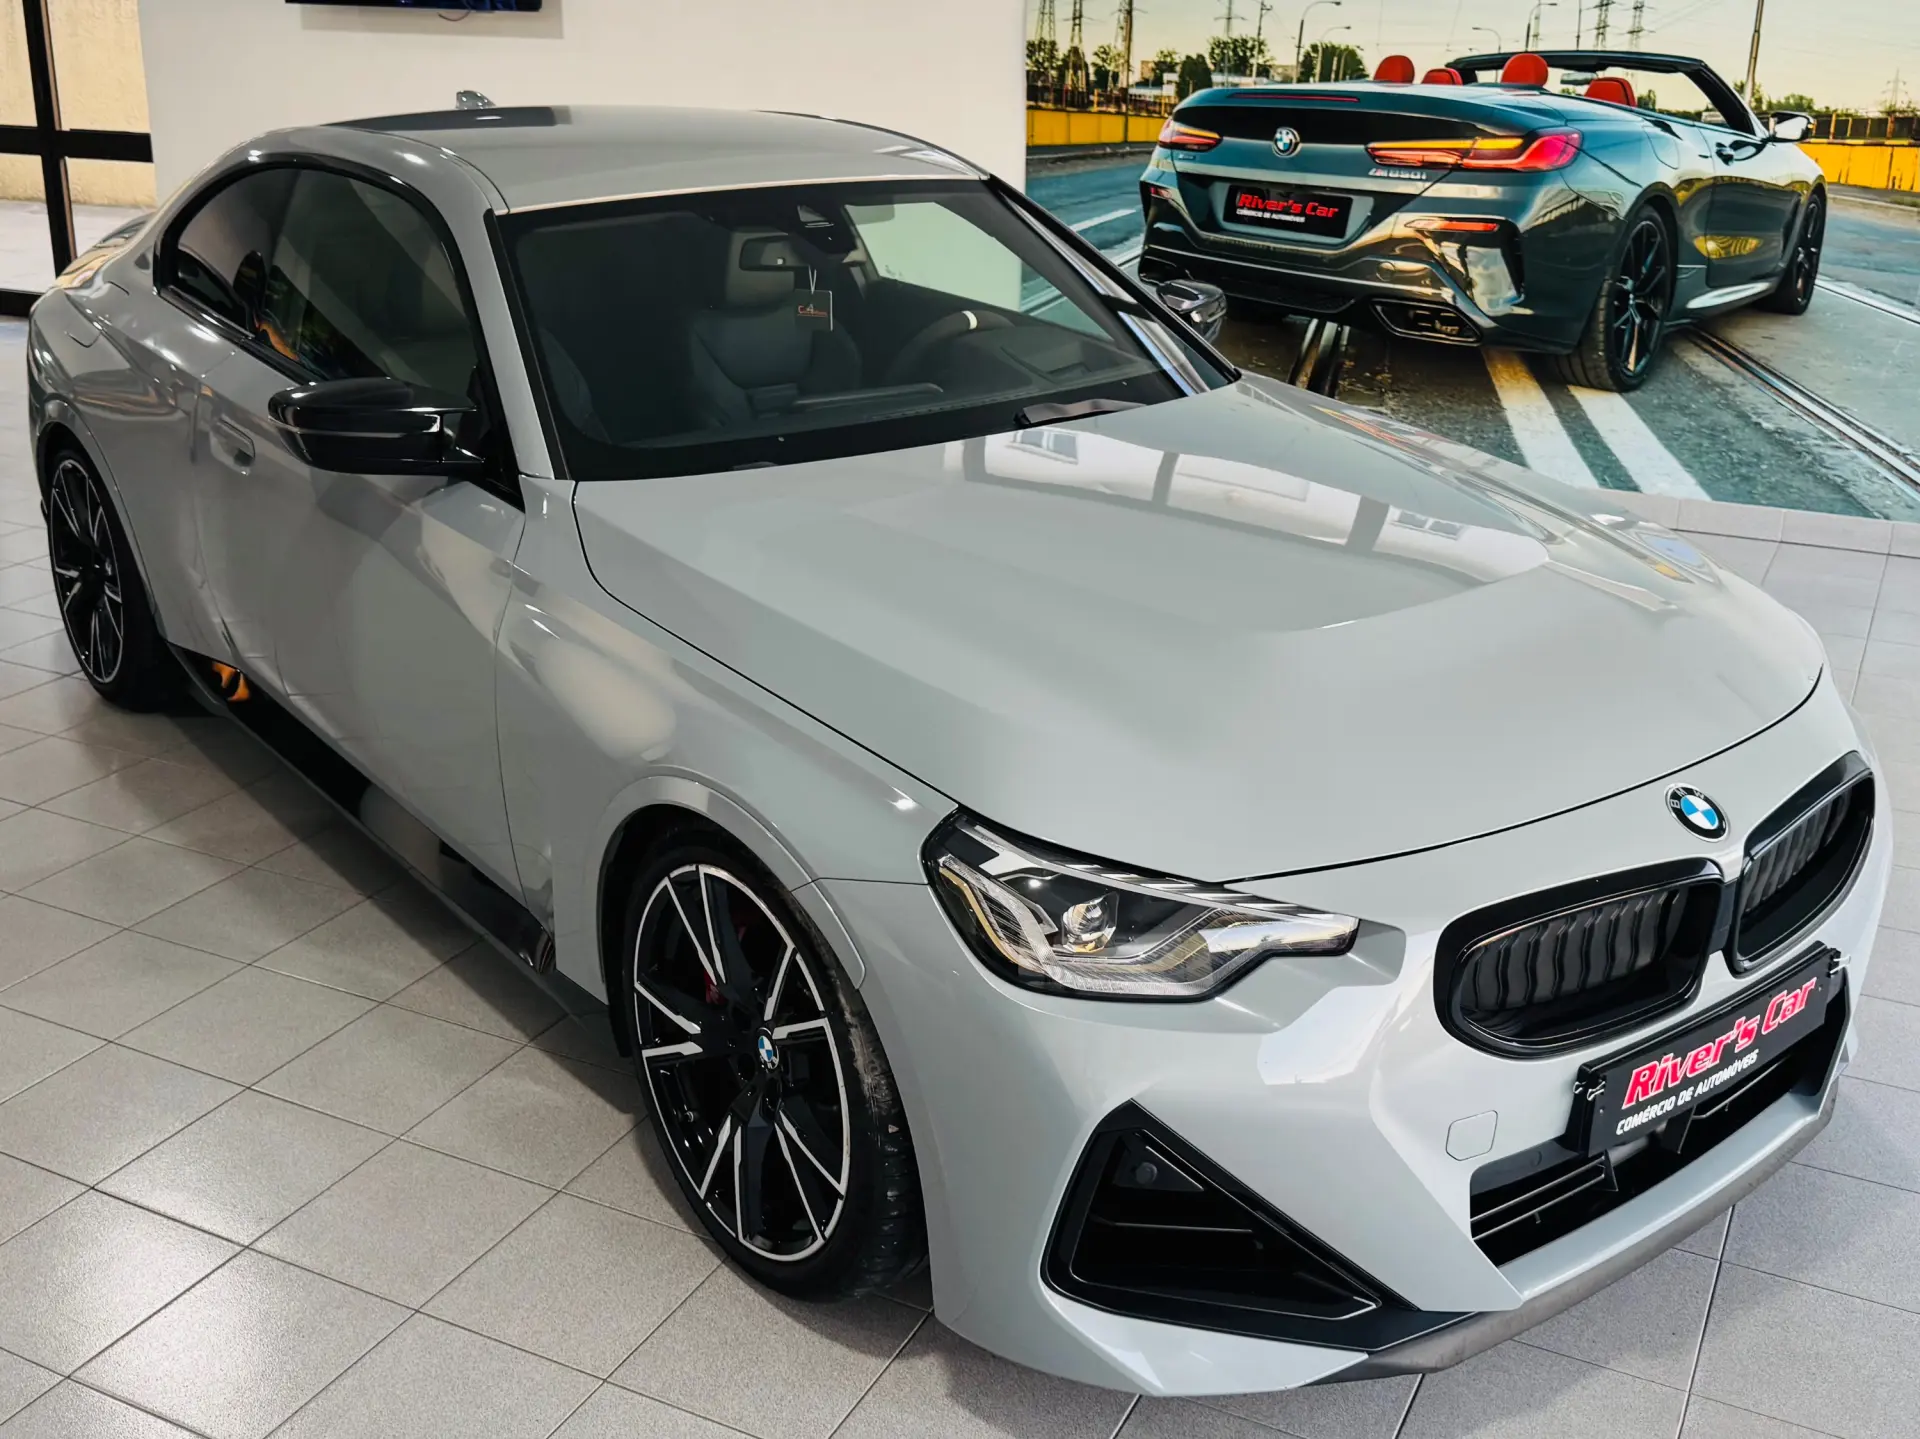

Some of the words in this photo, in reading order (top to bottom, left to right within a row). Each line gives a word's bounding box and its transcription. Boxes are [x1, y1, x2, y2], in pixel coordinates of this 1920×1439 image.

[1237, 193, 1303, 214] River's
[1305, 201, 1339, 218] Car
[1621, 1014, 1760, 1110] River's
[1761, 976, 1817, 1035] Car
[1615, 1095, 1676, 1136] COMÉRCIO
[1676, 1086, 1695, 1107] DE
[1694, 1048, 1760, 1097] AUTOMÓVEIS
